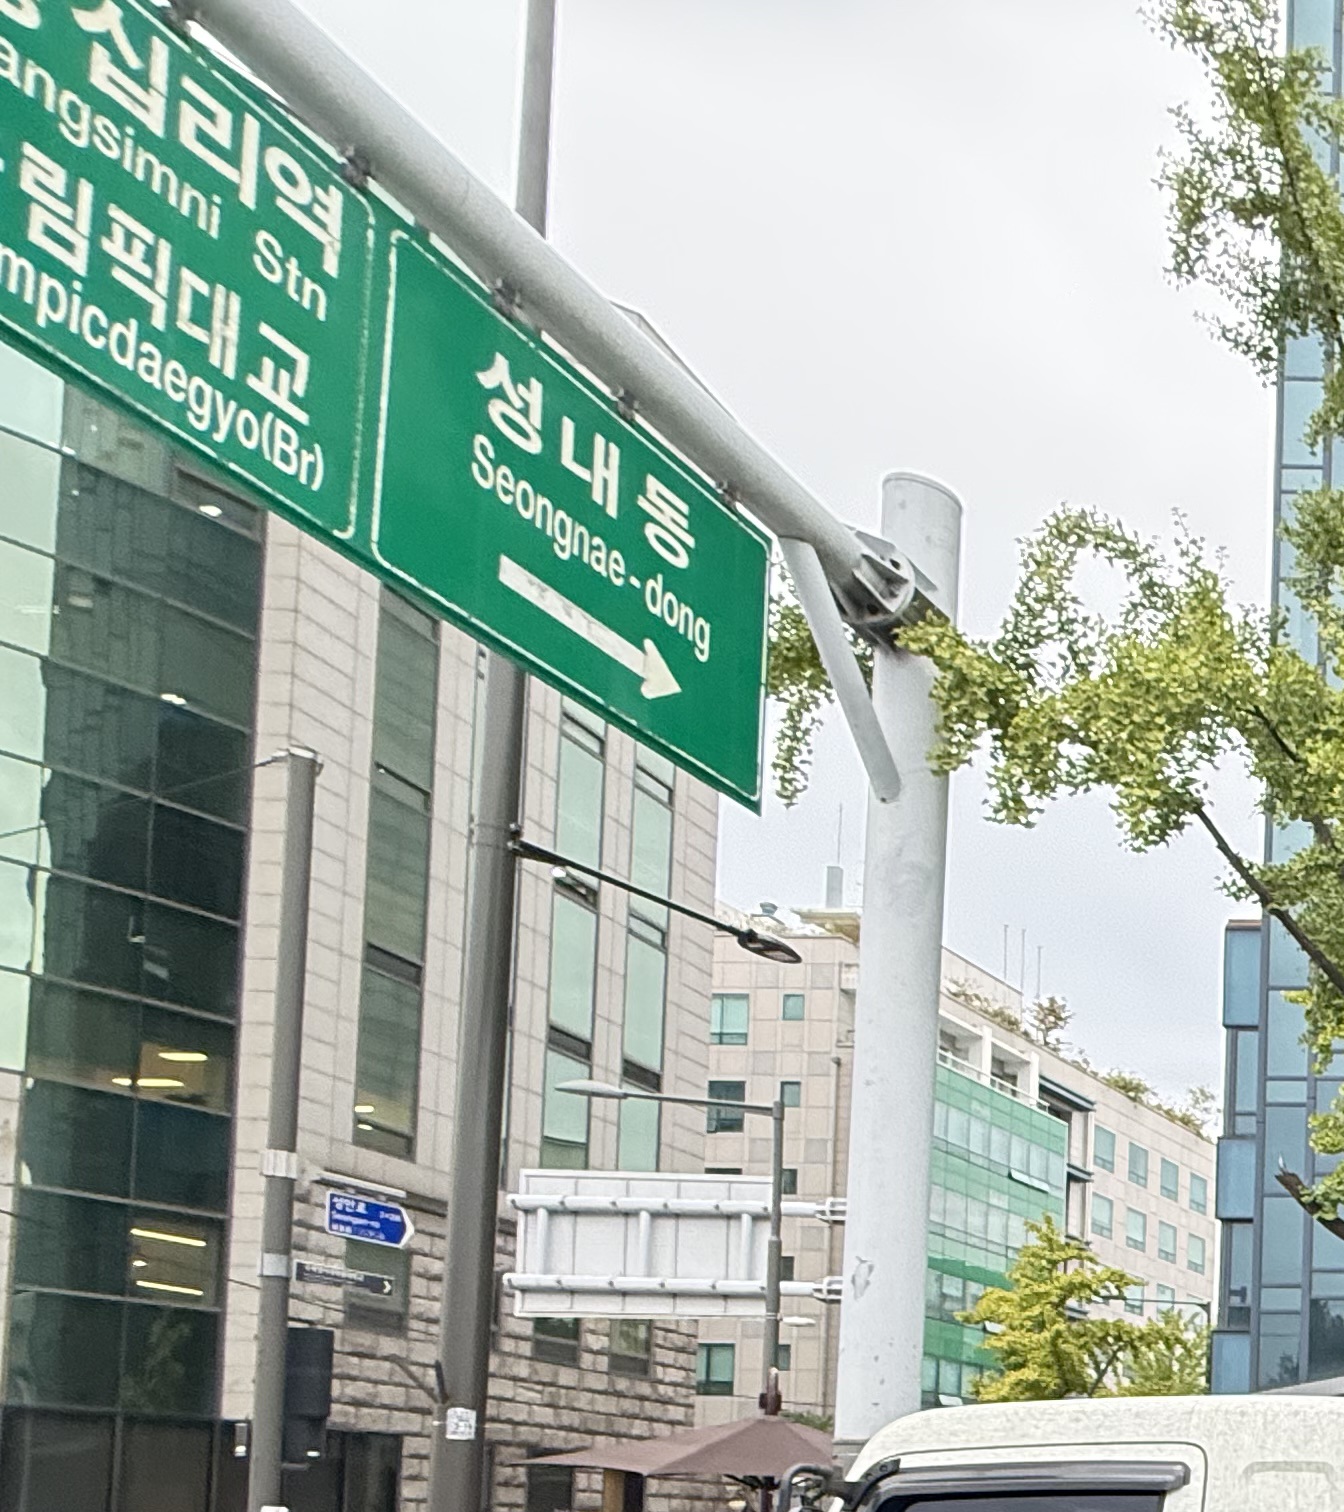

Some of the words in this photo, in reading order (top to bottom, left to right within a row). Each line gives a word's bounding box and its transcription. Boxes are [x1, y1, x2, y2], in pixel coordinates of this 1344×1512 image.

[0, 0, 343, 279] 십리역
[0, 142, 310, 426] 림픽대교
[253, 229, 327, 322] Stn
[471, 433, 711, 662] Seongnae-dong
[476, 352, 696, 569] 성내동
